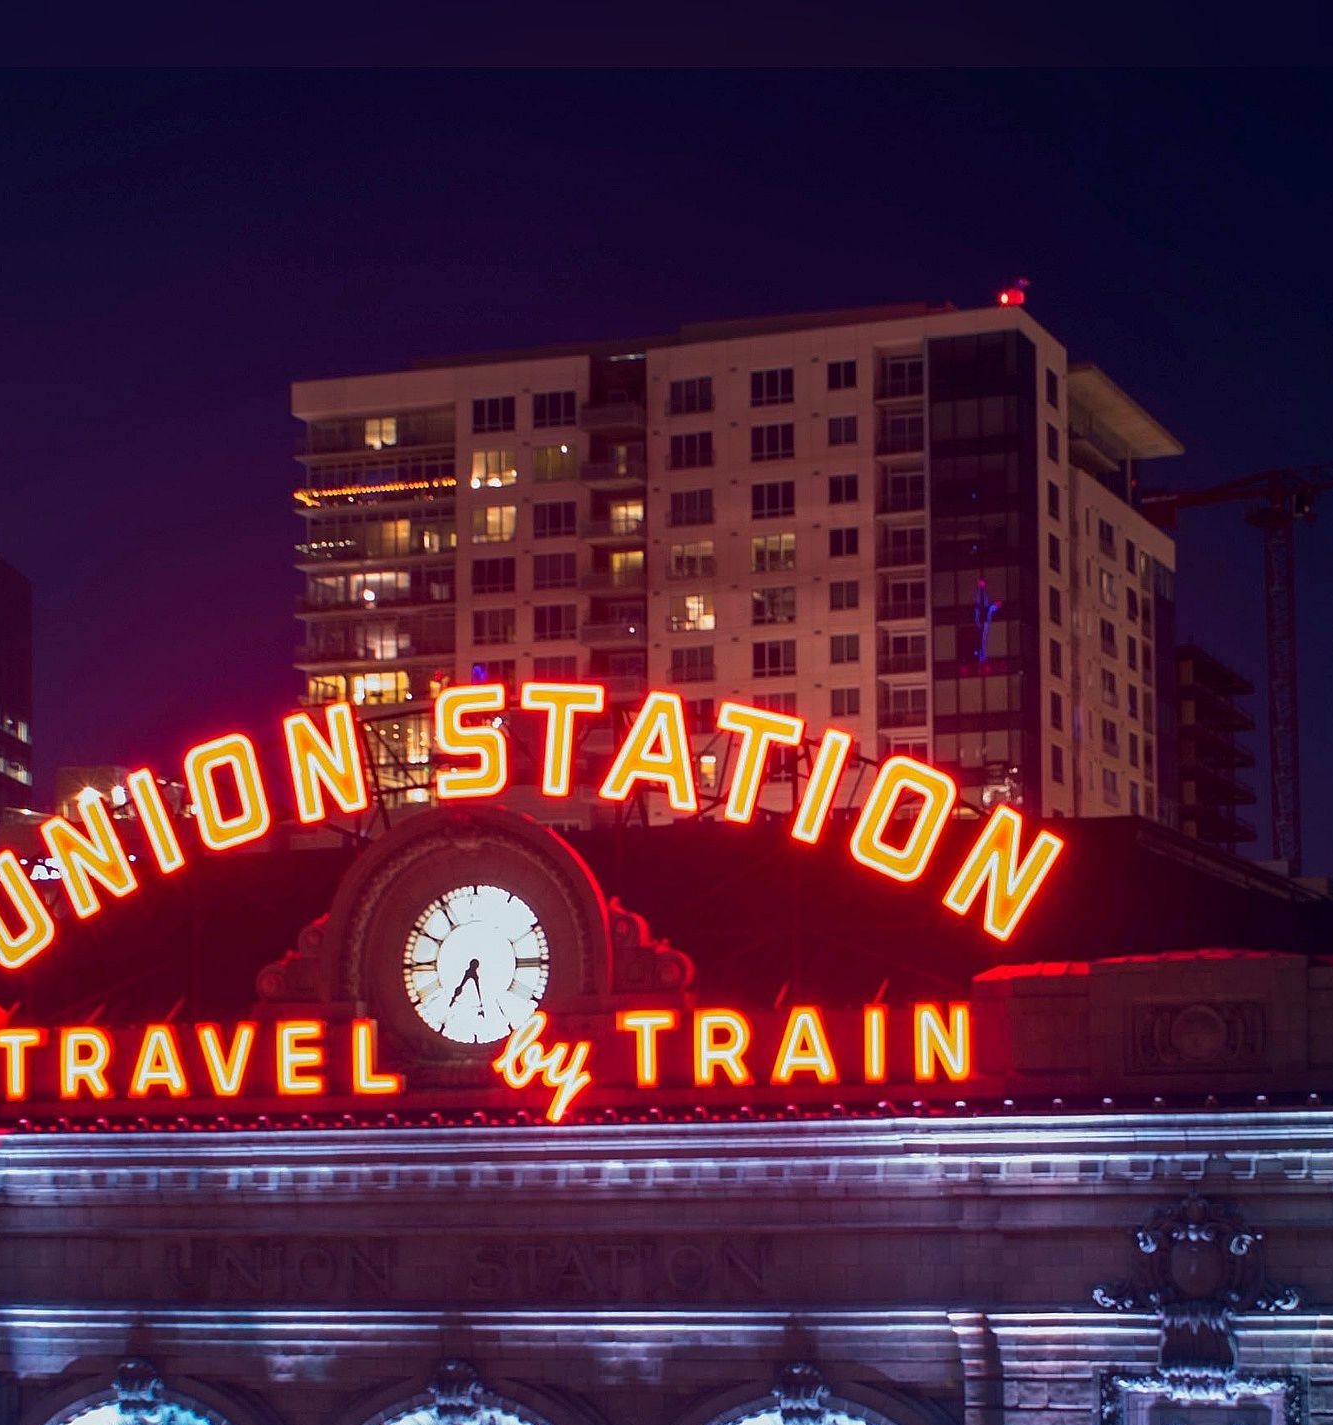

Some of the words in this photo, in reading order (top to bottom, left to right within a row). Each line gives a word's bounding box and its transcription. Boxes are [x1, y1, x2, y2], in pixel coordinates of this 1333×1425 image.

[435, 682, 1064, 941] STATION
[493, 1011, 592, 1123] by
[616, 1003, 970, 1088] TRAIN
[167, 1243, 393, 1292] UNION
[468, 1242, 770, 1292] STATION
